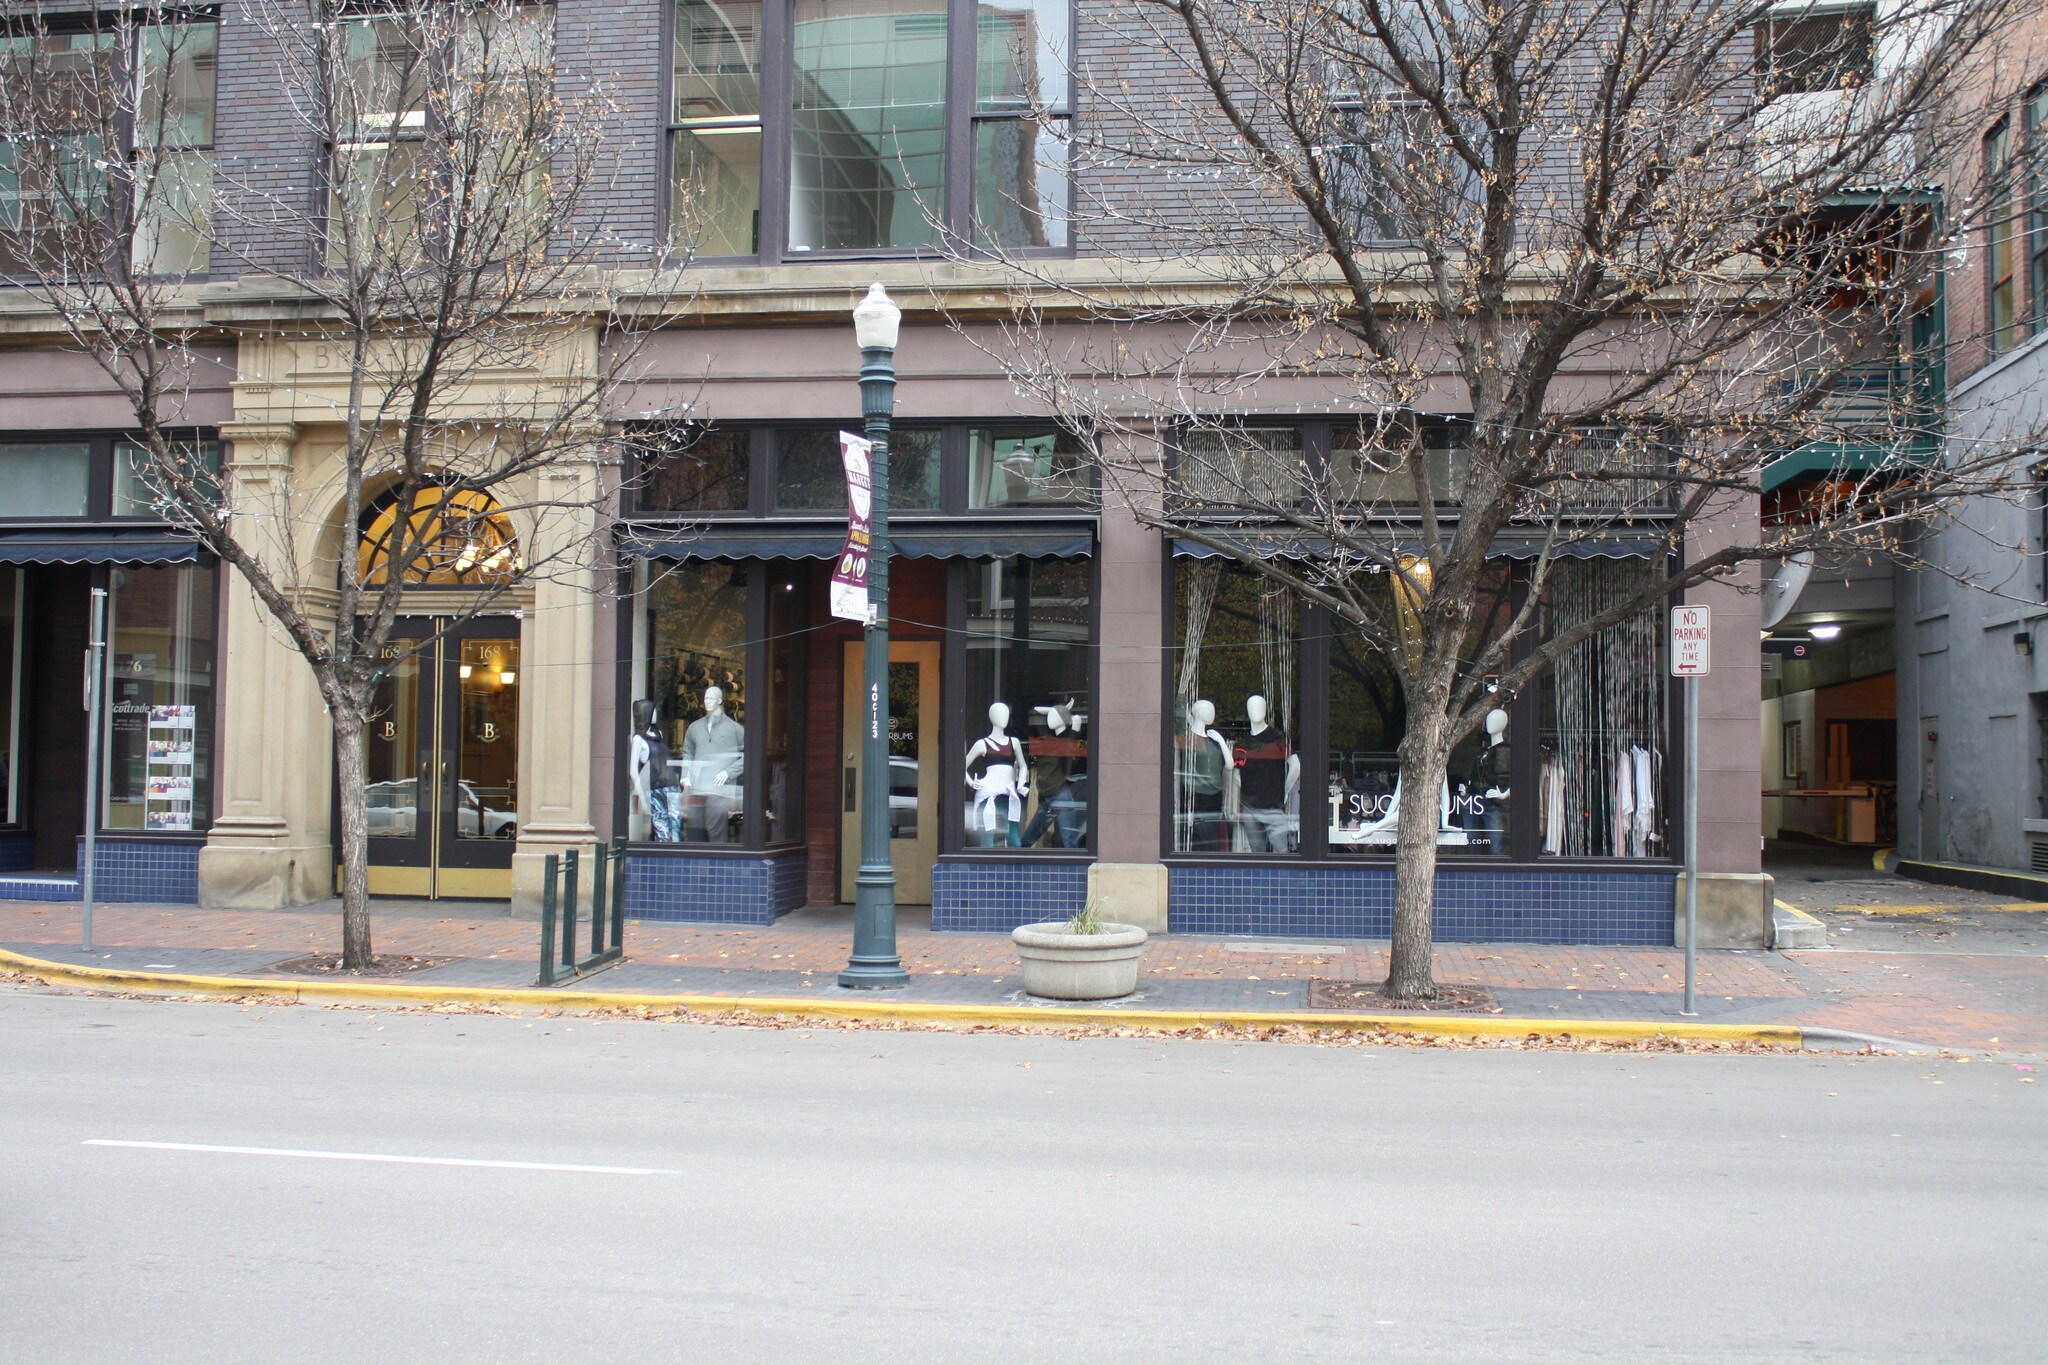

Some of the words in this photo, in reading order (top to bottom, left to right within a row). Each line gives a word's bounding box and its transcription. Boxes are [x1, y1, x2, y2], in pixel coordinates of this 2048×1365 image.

[1683, 612, 1698, 625] NO
[1674, 627, 1707, 641] PARKING
[479, 645, 501, 659] 168
[1682, 642, 1698, 651] ANY
[1681, 652, 1699, 661] TIME
[112, 702, 150, 713] cottrade
